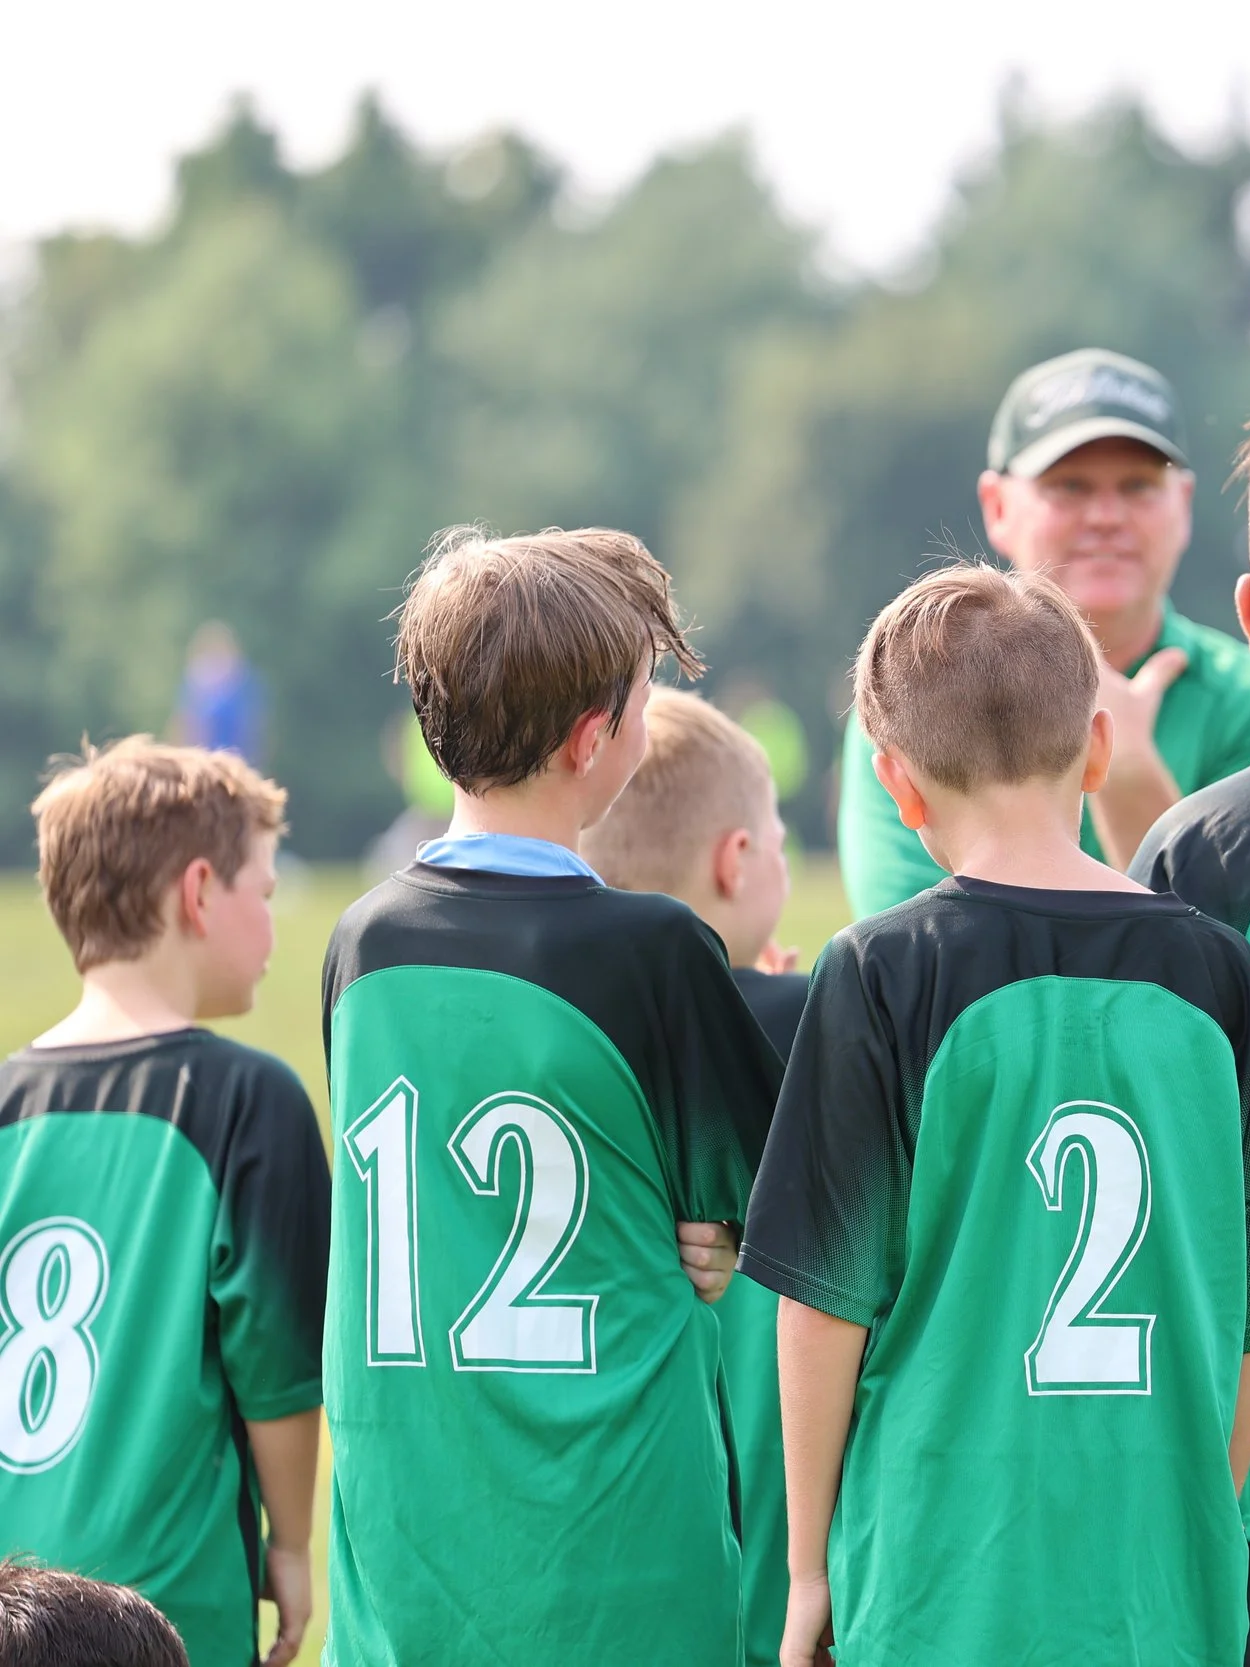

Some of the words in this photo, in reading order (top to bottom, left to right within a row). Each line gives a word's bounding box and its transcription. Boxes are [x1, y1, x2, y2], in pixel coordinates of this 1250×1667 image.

[0, 1216, 110, 1475] 8
[340, 1075, 600, 1375] 12
[1024, 1100, 1157, 1397] 2
